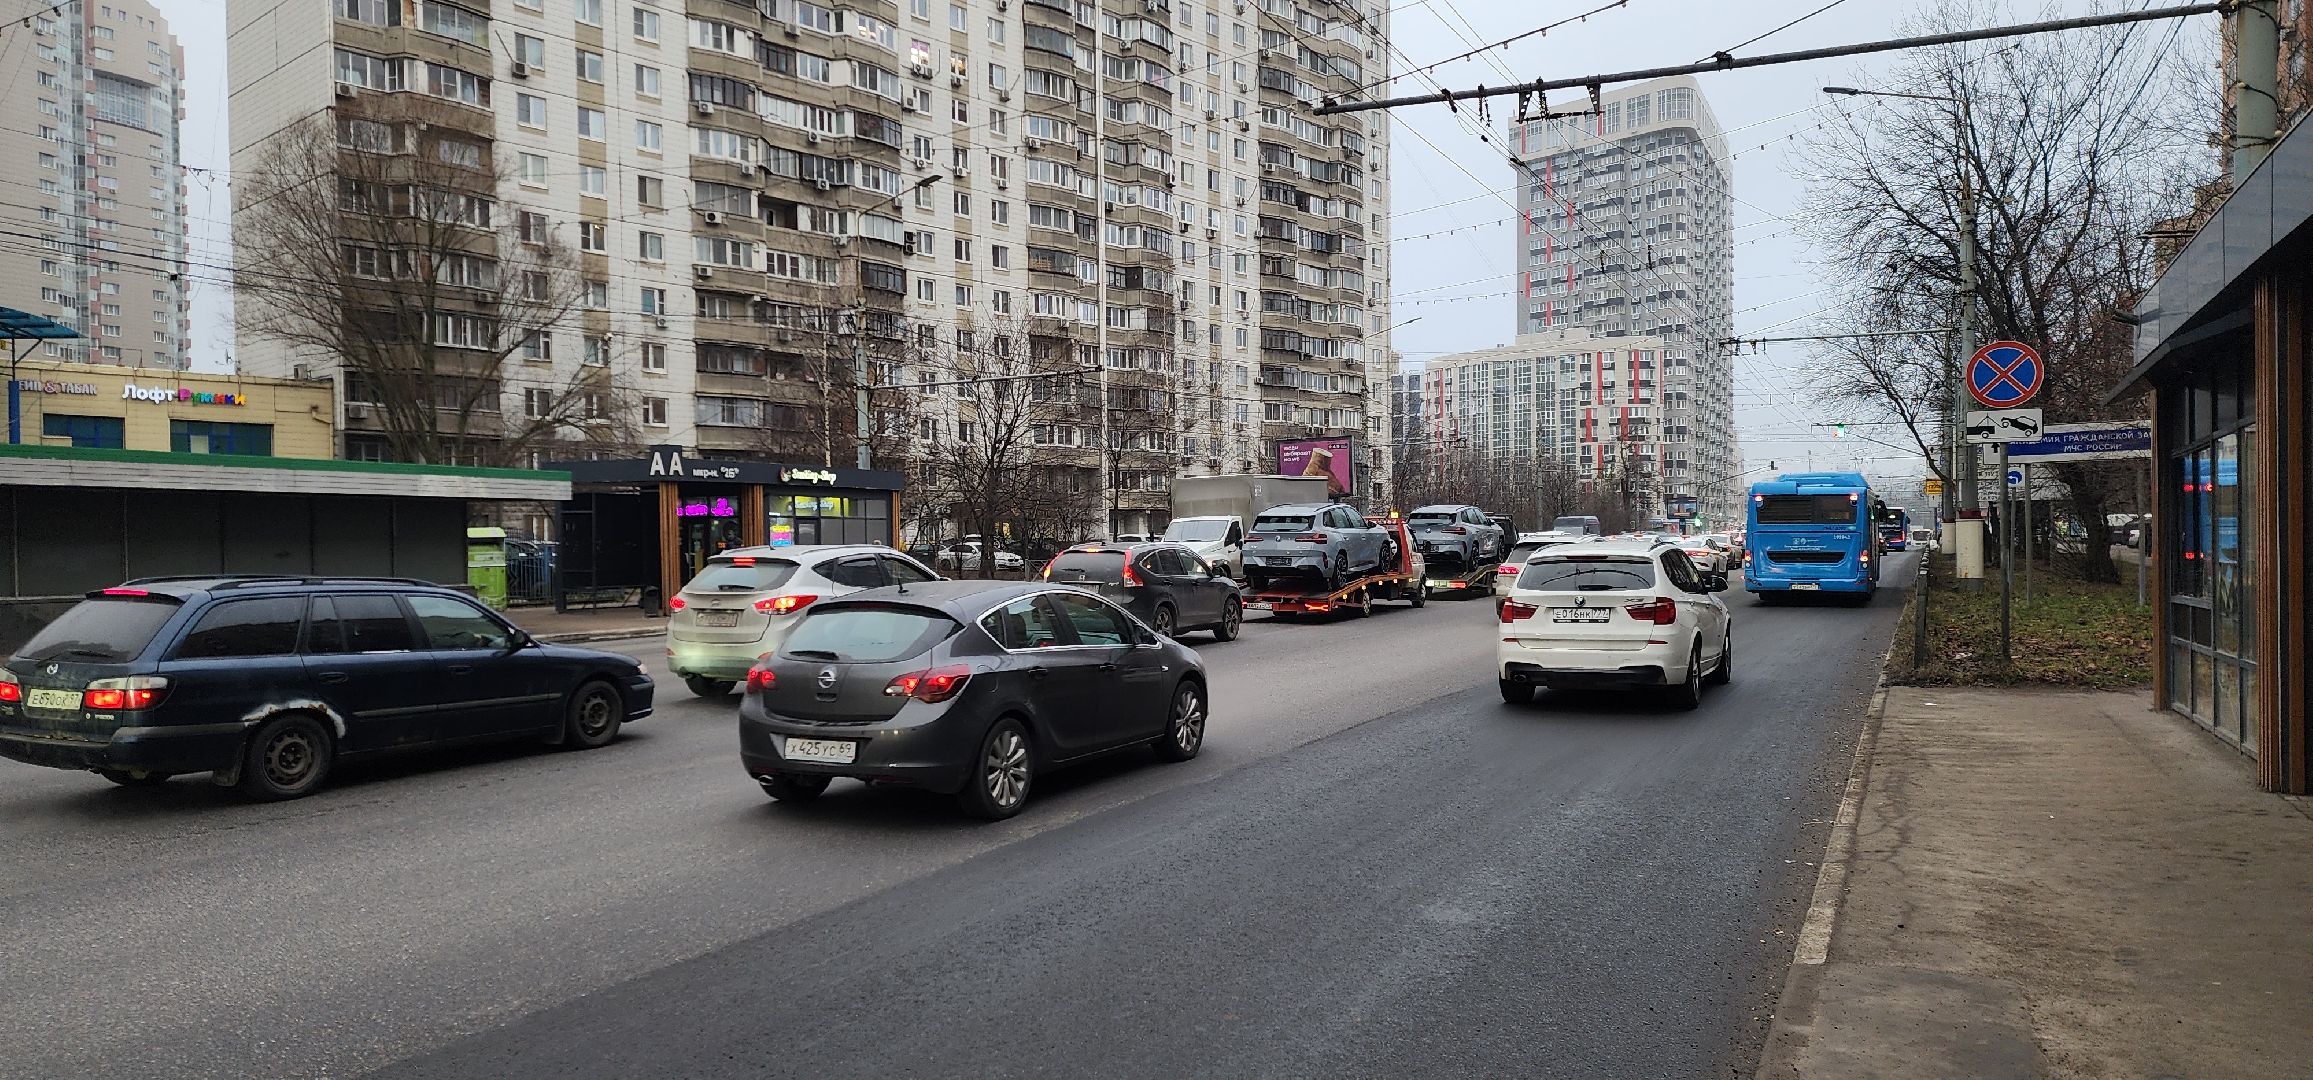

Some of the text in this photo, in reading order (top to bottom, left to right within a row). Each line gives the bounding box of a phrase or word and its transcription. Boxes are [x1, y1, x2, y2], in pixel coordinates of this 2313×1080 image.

[45, 381, 57, 394] &
[60, 383, 97, 395] ТАБАК
[122, 384, 175, 405] Лофт
[2064, 430, 2133, 443] ГРАЖДАНСКОЙ
[2063, 443, 2122, 453] МЧС РОССИИ
